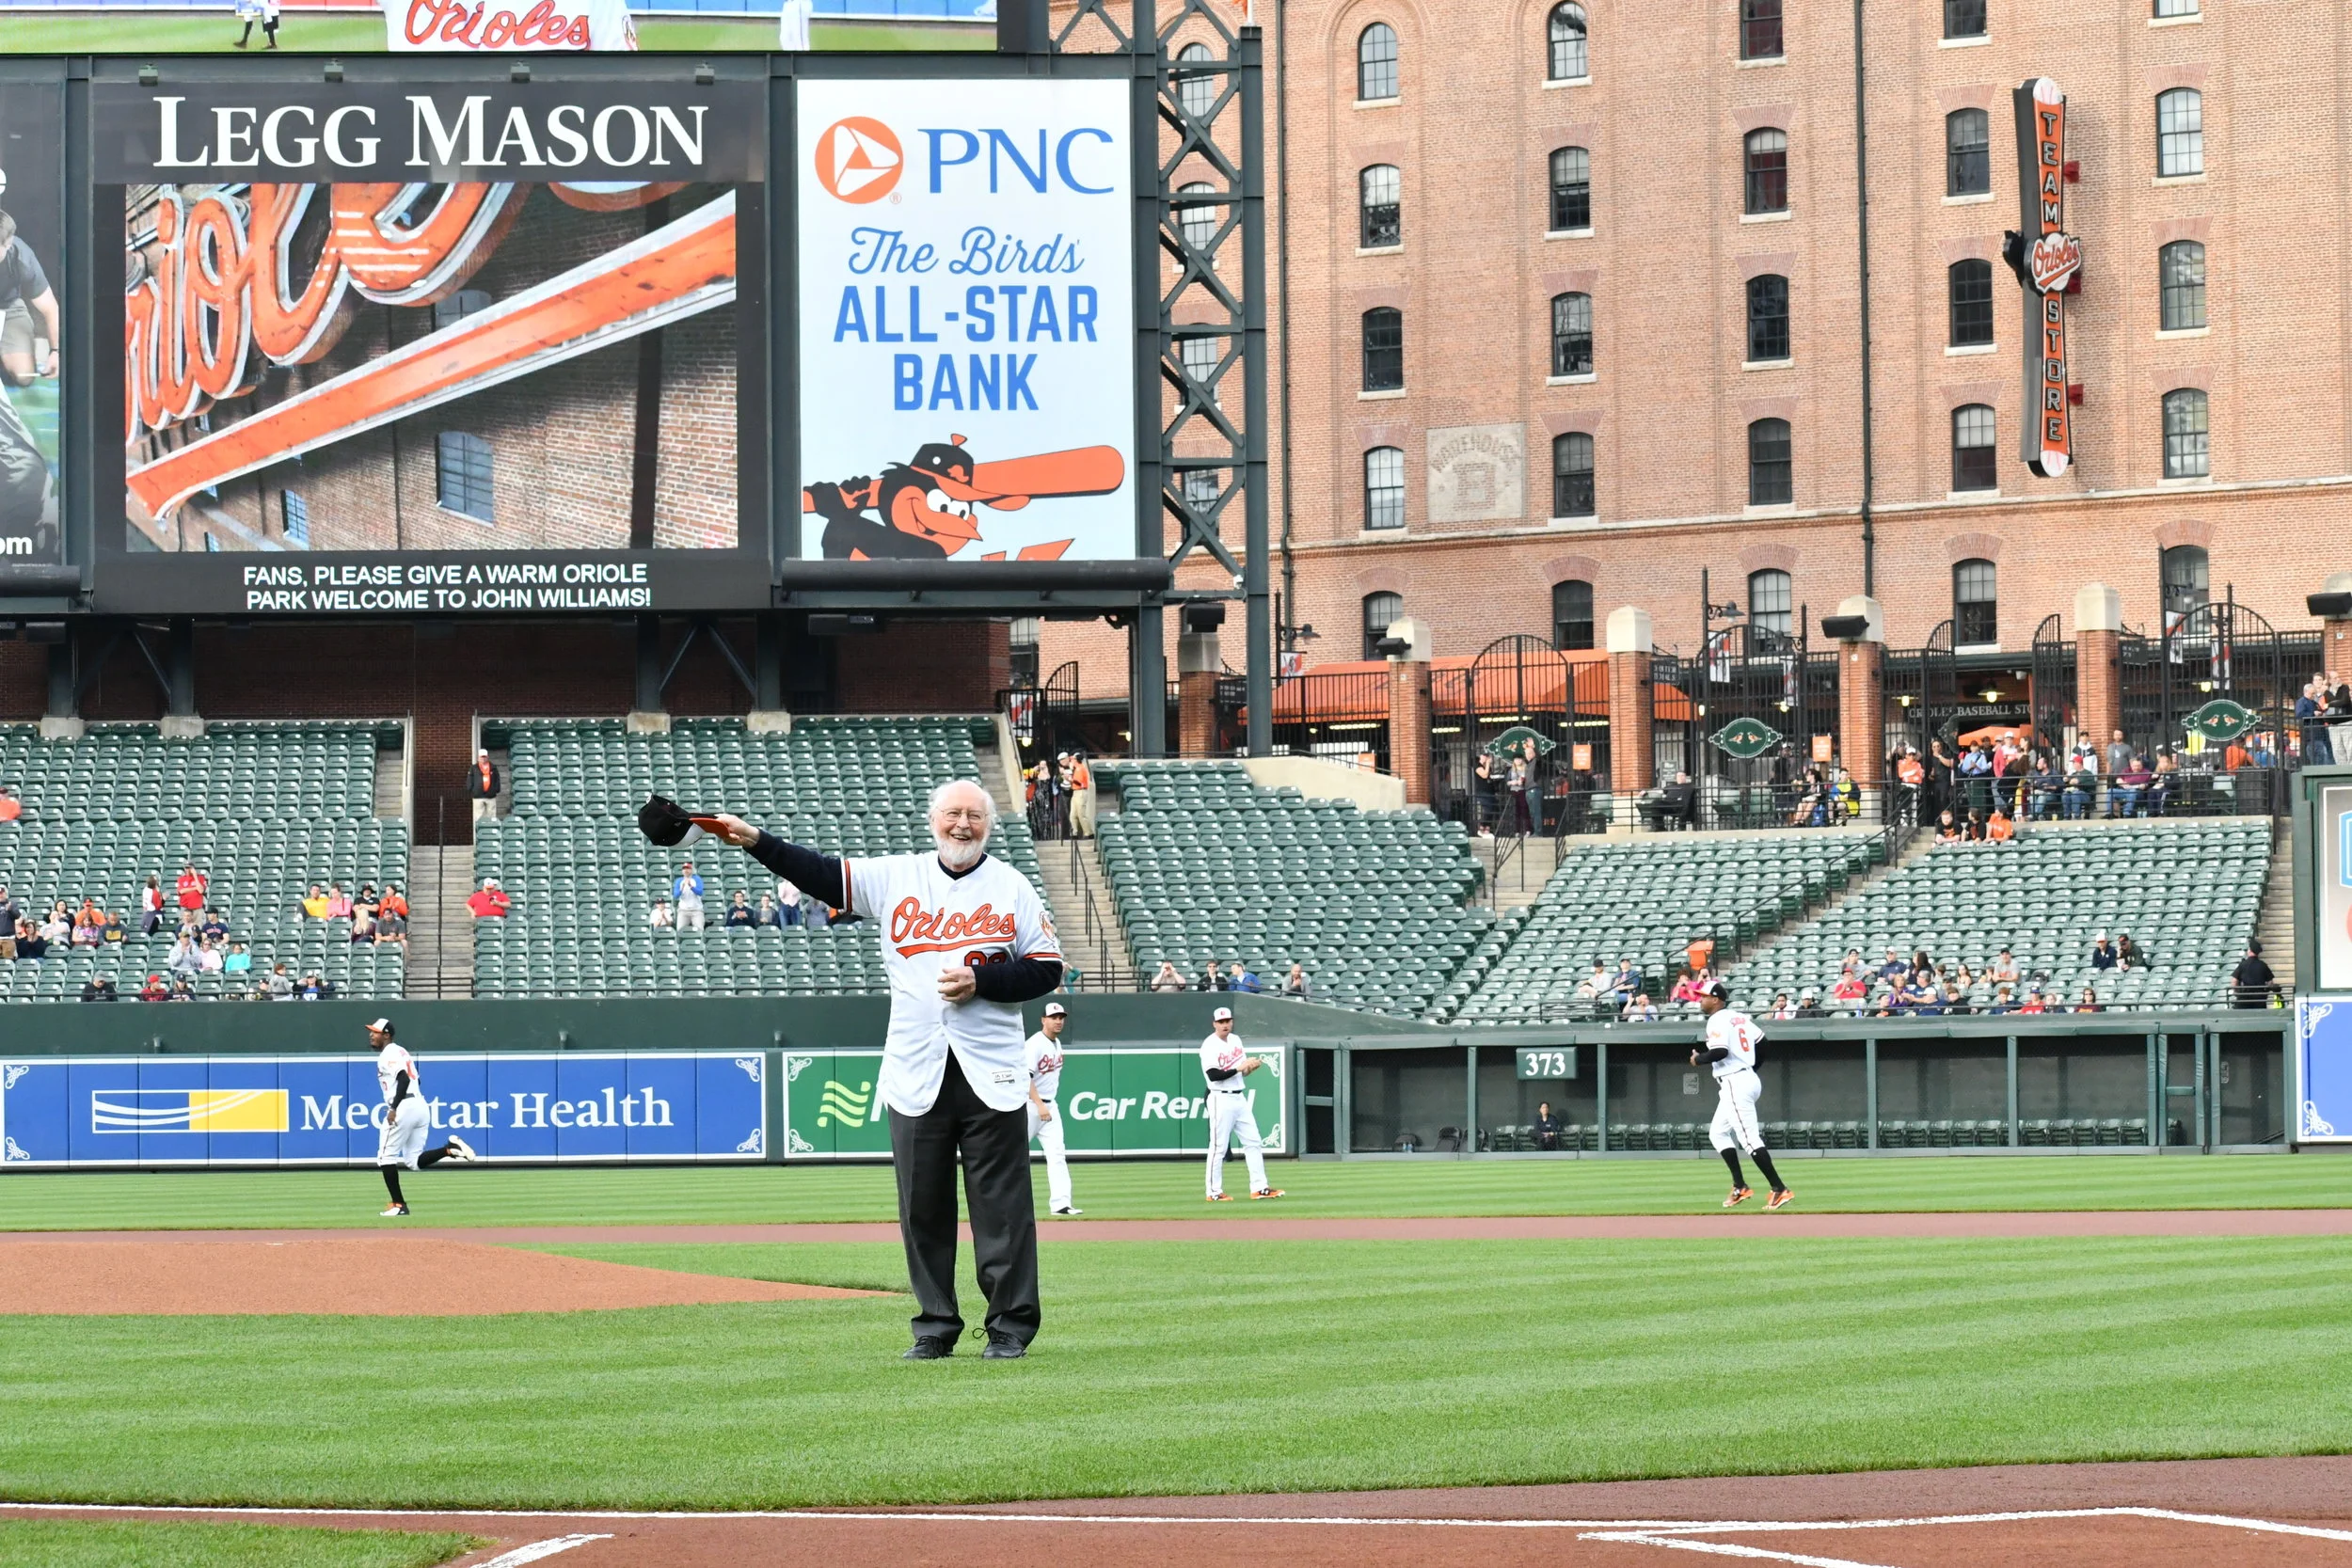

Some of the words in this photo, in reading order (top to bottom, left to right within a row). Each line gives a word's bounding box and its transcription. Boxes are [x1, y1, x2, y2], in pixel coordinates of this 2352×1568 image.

[405, 0, 591, 51] Orioles
[152, 95, 381, 167] LEGG
[405, 94, 708, 166] MASON
[917, 127, 1114, 195] PNC
[2040, 111, 2059, 226] TEAM
[849, 227, 939, 275] The
[2033, 238, 2078, 277] Orioles
[834, 285, 1098, 343] ALL-STAR
[893, 354, 1040, 411] BANK
[2045, 299, 2063, 442] STORE
[244, 565, 308, 587] FANS,
[314, 565, 402, 585] PLEASE
[407, 565, 461, 584] GIVE
[466, 565, 483, 584] A
[486, 564, 557, 584] WARM
[563, 563, 647, 584] ORIOLE
[246, 590, 307, 610] PARK
[311, 589, 430, 610] WELCOME
[434, 589, 467, 610] TO
[471, 588, 532, 610] JOHN
[535, 587, 651, 609] WILLIAMS!
[1957, 705, 2011, 716] BASEBALL
[890, 895, 1017, 944] Orioles
[1739, 1027, 1750, 1053] 6
[1525, 1052, 1566, 1077] 373
[300, 1094, 499, 1131] Metar
[510, 1086, 675, 1128] Health
[1069, 1090, 1138, 1121] Car
[1140, 1088, 1257, 1120] Renl
